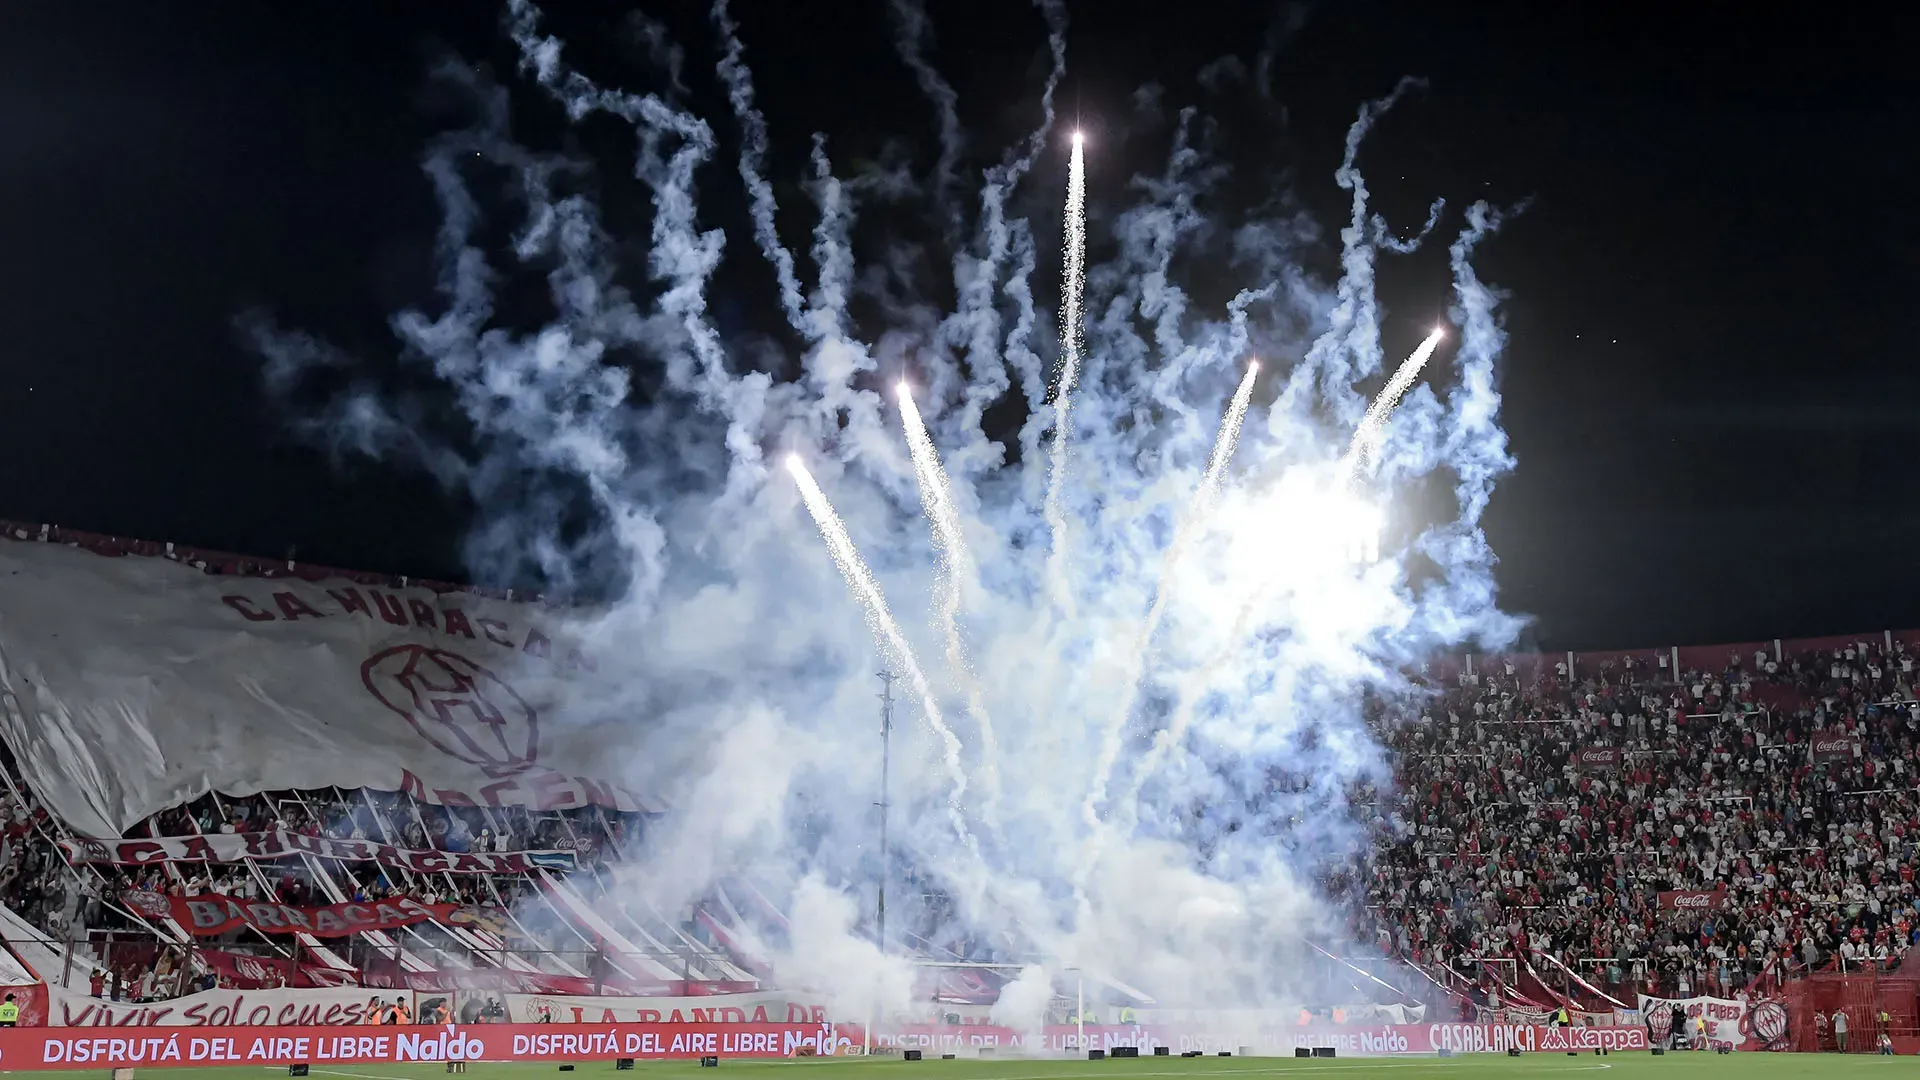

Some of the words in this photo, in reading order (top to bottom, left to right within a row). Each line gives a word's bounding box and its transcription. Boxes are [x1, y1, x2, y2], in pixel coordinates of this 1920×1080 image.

[186, 897, 435, 932] BARRACAS
[43, 1033, 181, 1063] DISFRUTÁ
[189, 1037, 241, 1061] DEL
[247, 1037, 311, 1060] AIRE
[316, 1036, 389, 1059] LIBRE
[395, 1024, 485, 1061] Naldo
[513, 1028, 620, 1055] DISFRUTÁ
[625, 1032, 666, 1054] DEL
[670, 1032, 717, 1053] AIRE
[723, 1032, 779, 1053] LIBRE
[1360, 1025, 1408, 1053] Naldo
[1429, 1023, 1536, 1052] CASABLANCA
[1568, 1027, 1645, 1051] Kappa
